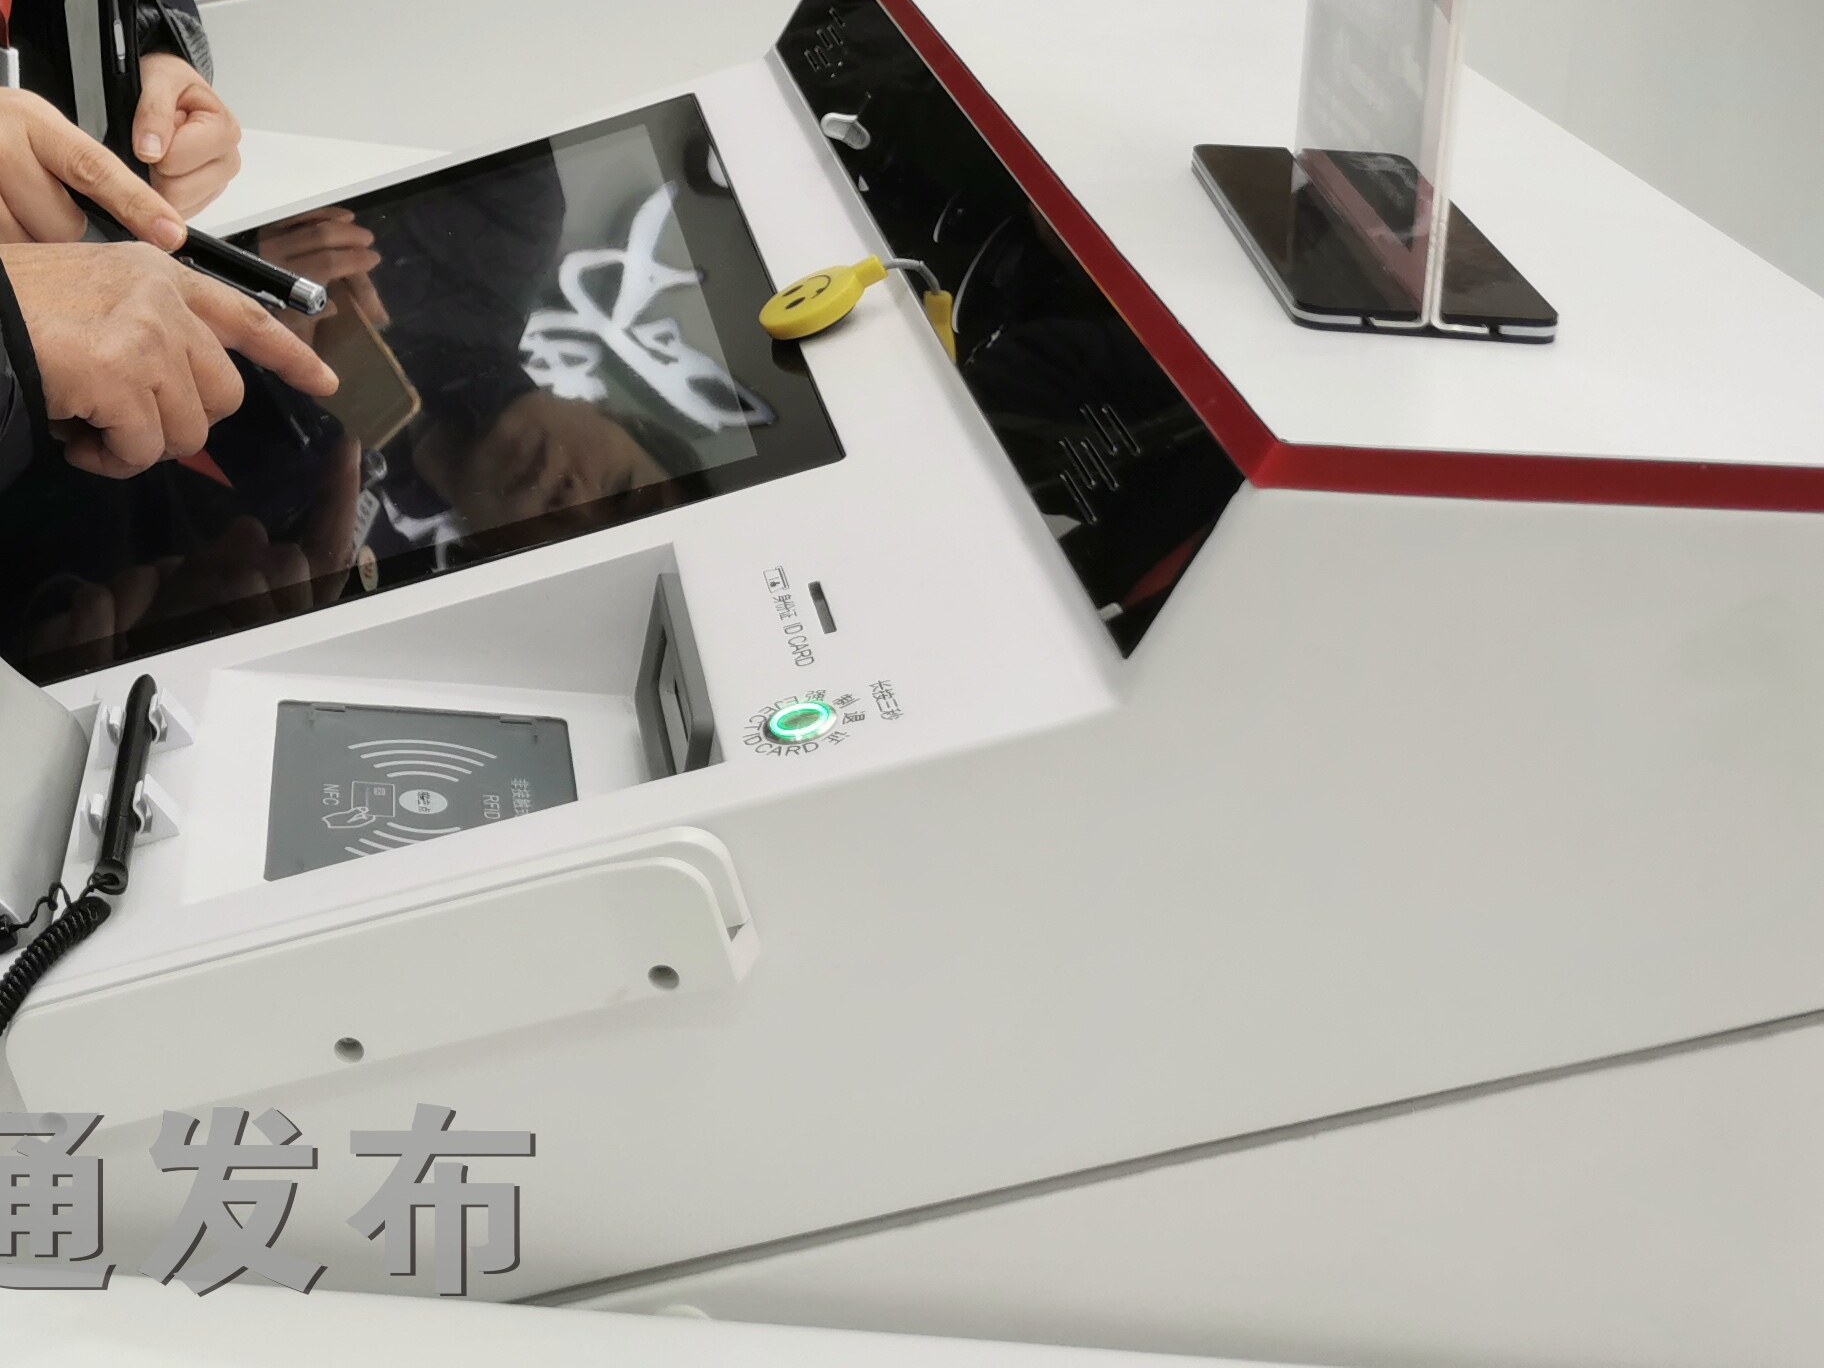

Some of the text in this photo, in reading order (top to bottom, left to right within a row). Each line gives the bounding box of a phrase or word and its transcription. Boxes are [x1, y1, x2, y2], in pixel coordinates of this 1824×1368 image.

[772, 593, 815, 667] 身份证 ID CARD
[322, 783, 340, 807] NFC
[482, 793, 501, 820] RFID
